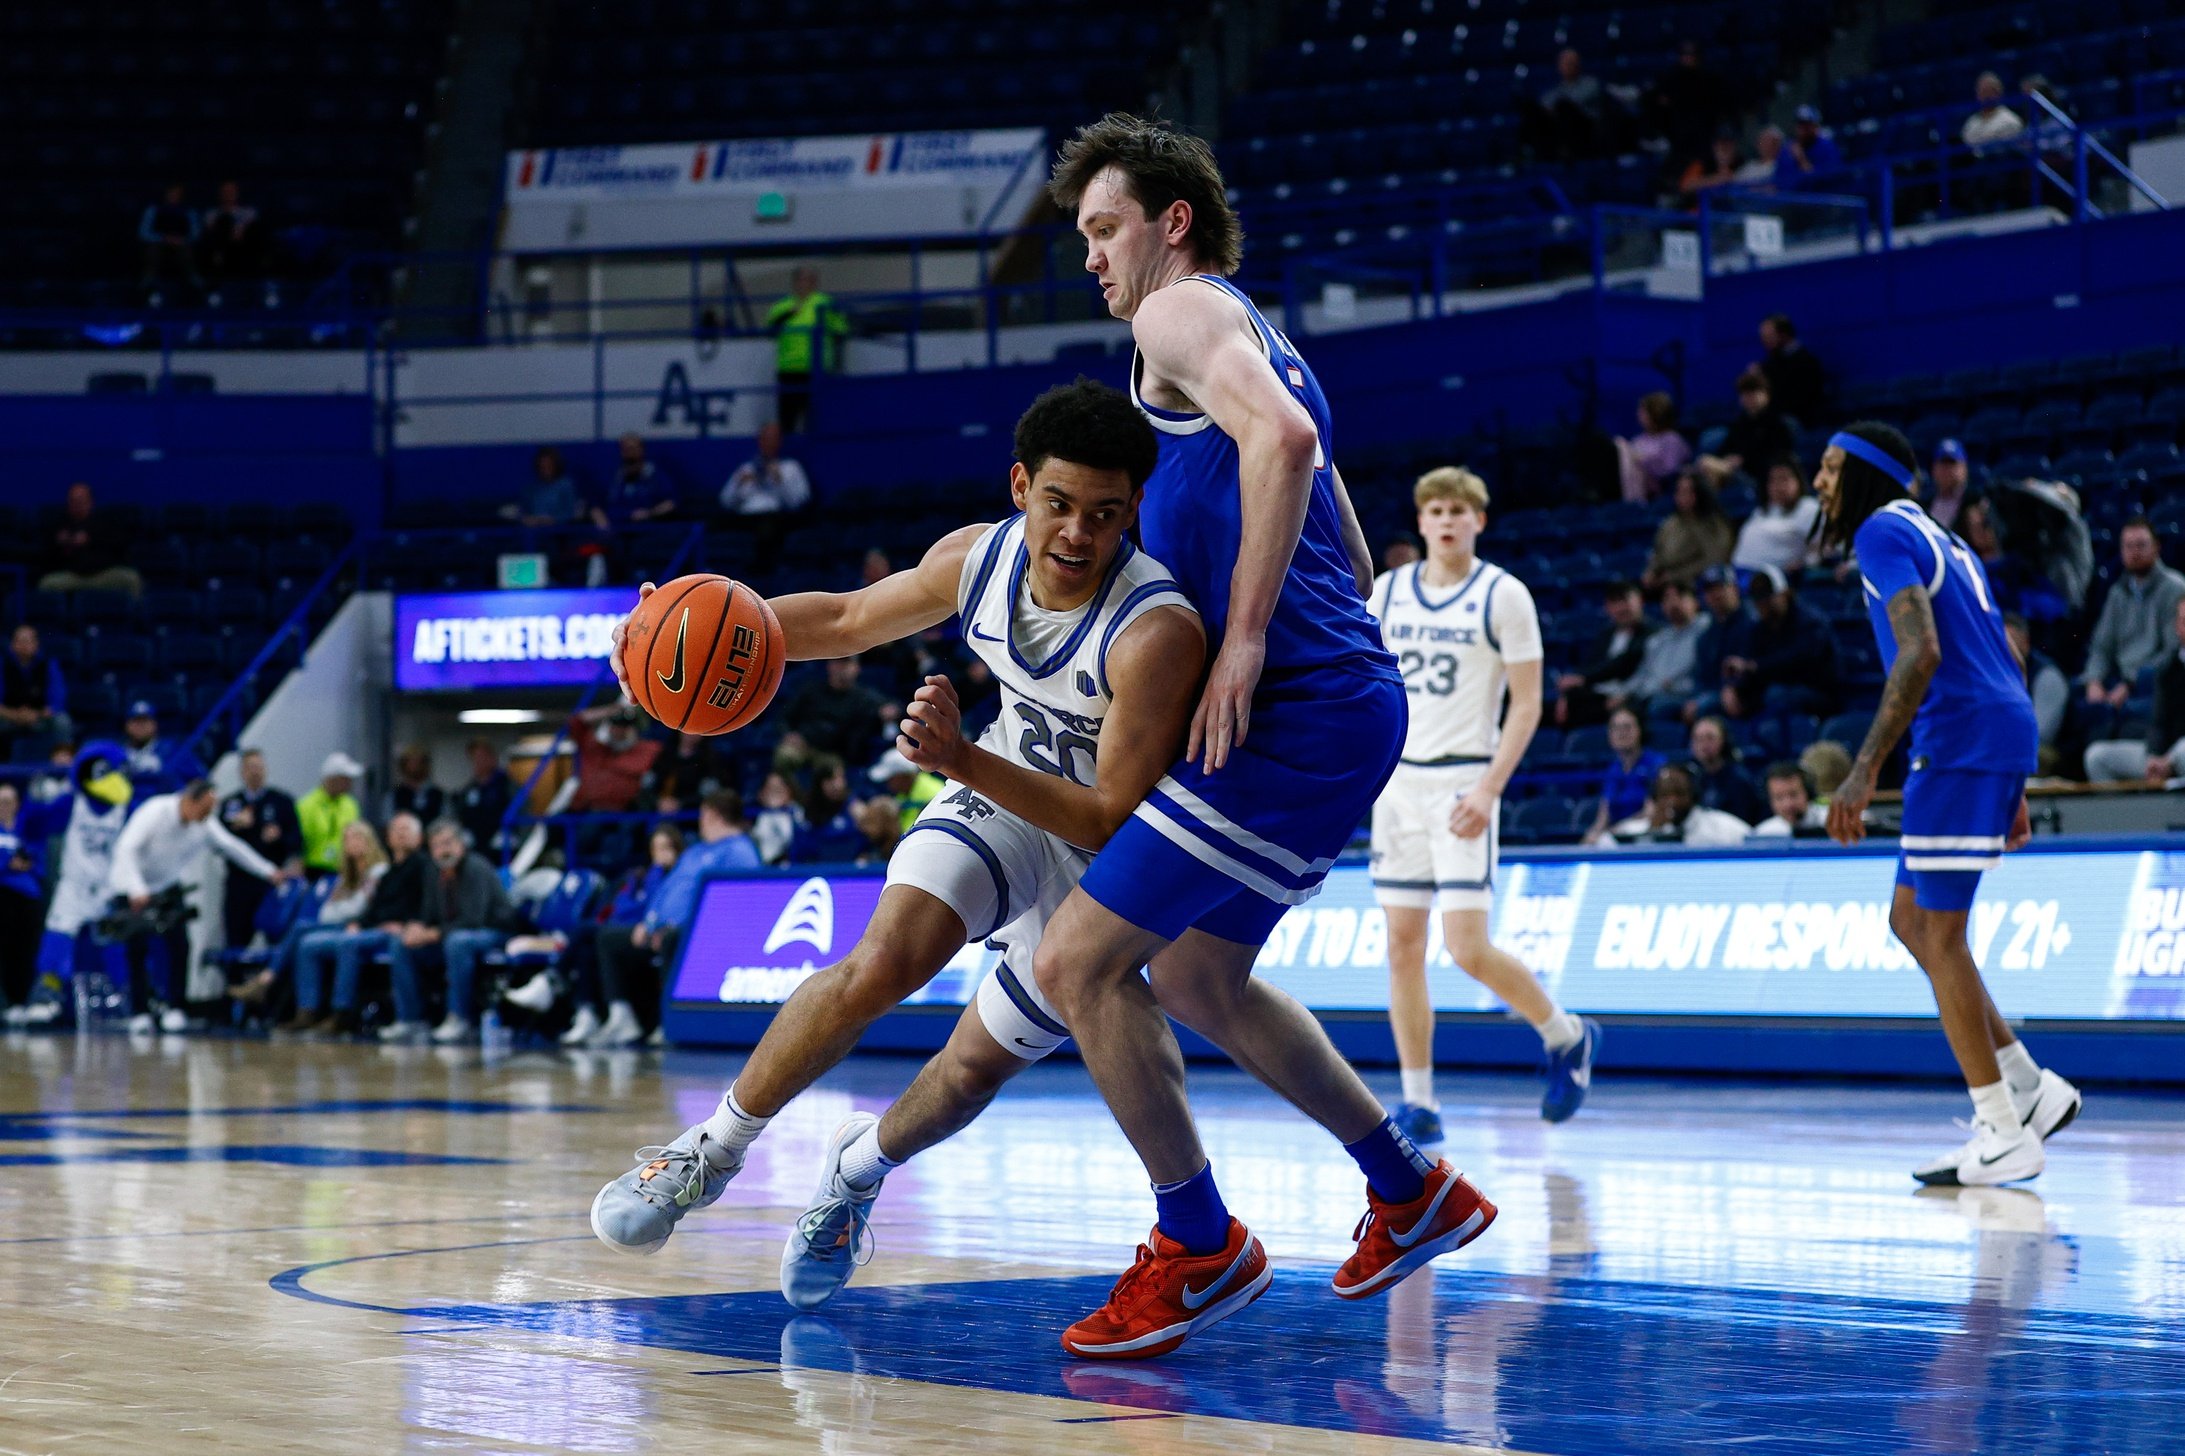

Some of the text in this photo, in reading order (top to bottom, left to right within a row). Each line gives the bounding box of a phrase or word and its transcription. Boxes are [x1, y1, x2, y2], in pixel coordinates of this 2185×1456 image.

[1417, 624, 1478, 645] FORCE
[707, 624, 755, 710] ELITE
[1400, 650, 1458, 696] 23
[1013, 702, 1097, 788] 20
[940, 786, 997, 822] AF
[2136, 887, 2185, 932] BU
[1307, 907, 1358, 967] TO
[1593, 899, 2072, 971] ENJOY RESPONSY 21+
[2113, 930, 2185, 977] LIG
[718, 959, 818, 1003] amen
